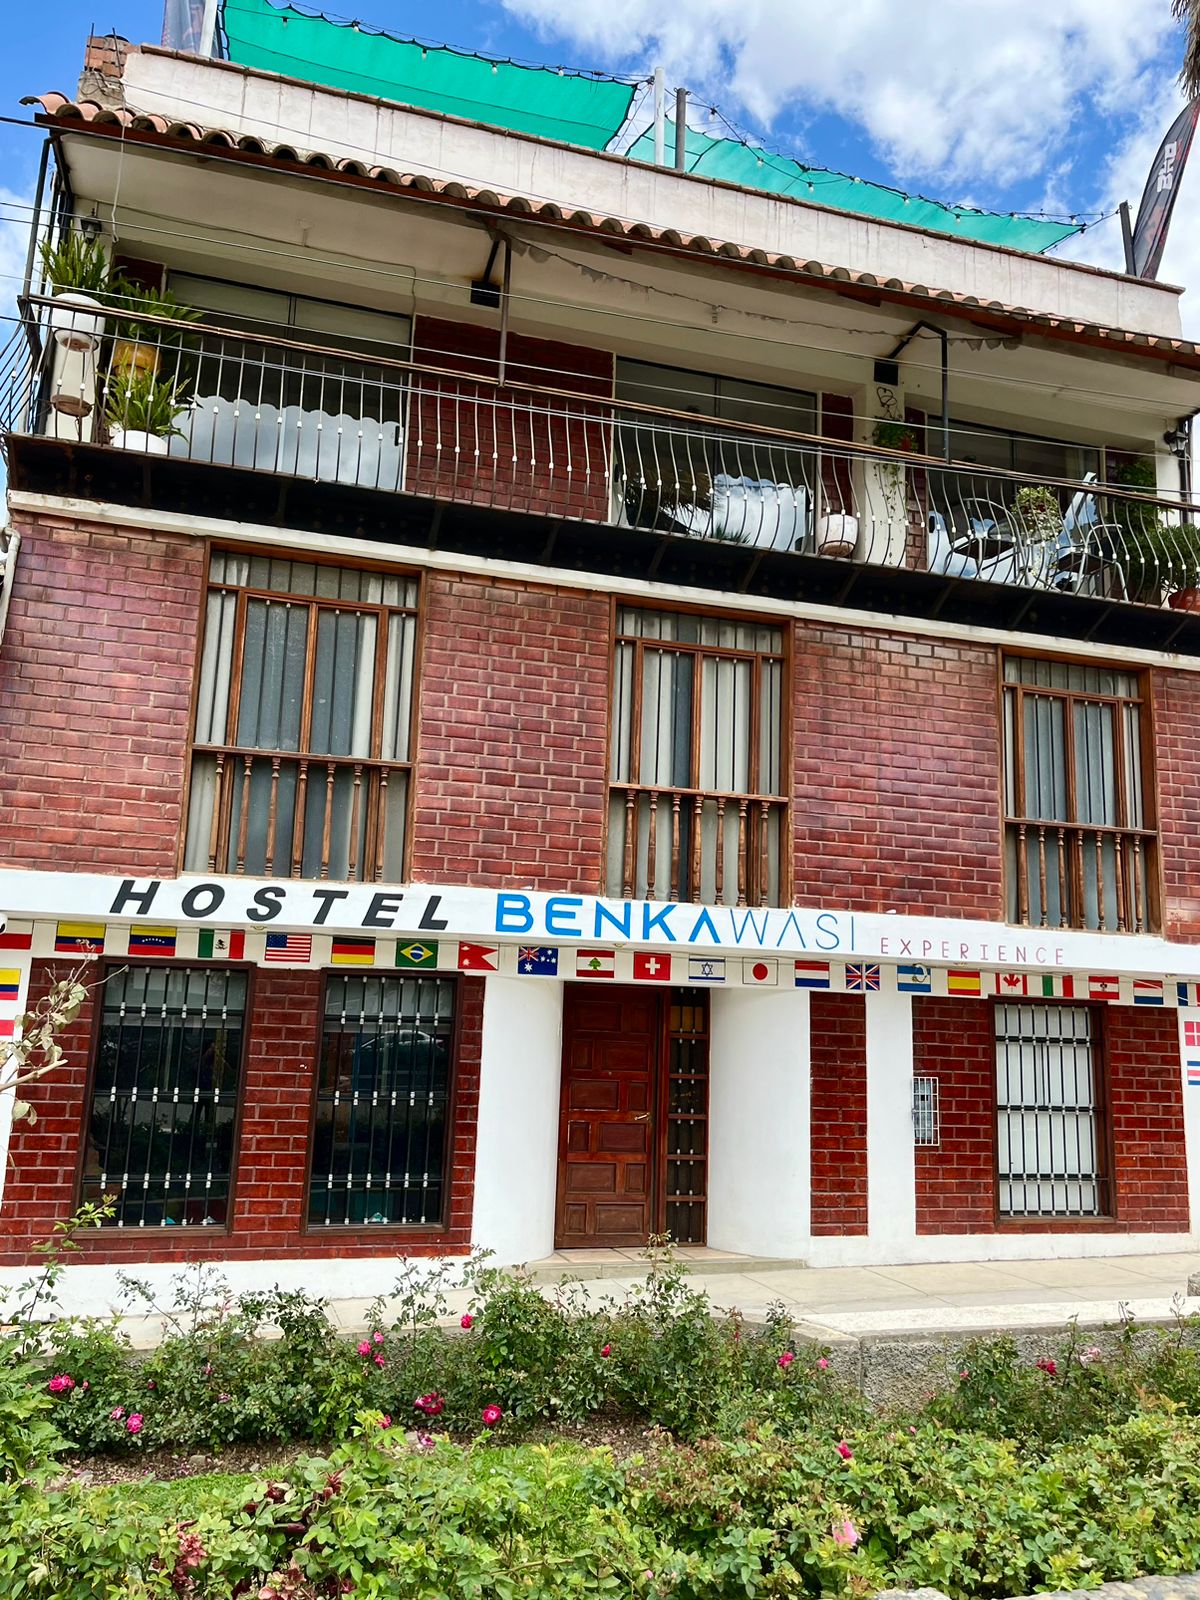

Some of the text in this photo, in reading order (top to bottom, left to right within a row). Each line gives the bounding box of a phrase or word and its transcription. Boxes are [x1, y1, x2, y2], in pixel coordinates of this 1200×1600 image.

[109, 879, 1064, 965] HOSTEL BENKAWASI EXPERIENCE
